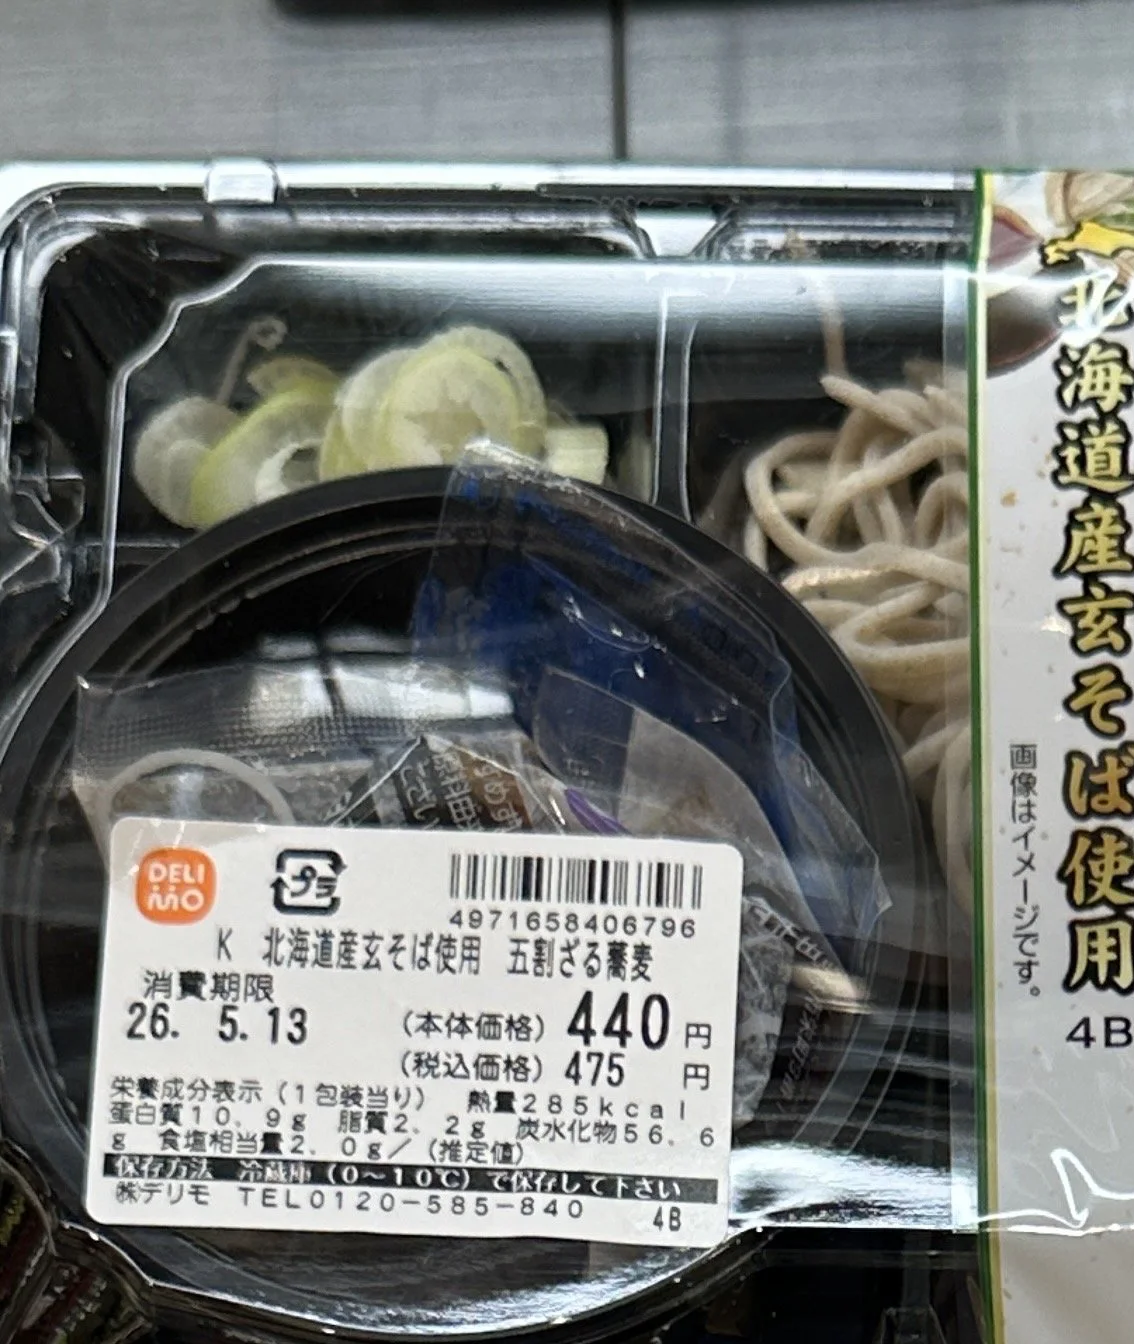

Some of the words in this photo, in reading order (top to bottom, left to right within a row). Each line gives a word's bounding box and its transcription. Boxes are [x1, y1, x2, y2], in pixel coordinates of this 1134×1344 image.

[148, 863, 206, 887] DELI
[288, 869, 336, 898] プラ
[1009, 742, 1042, 997] 画像はイメージです。
[450, 910, 697, 939] 4971658406796
[216, 931, 231, 961] K
[262, 928, 481, 975] 北海道産玄そば使用
[508, 938, 654, 982] 五割ざる蕎麦
[143, 972, 275, 1003] 消費期限
[567, 992, 671, 1051] 440
[686, 1023, 712, 1050] 円
[1066, 1016, 1134, 1048] 4B
[564, 1051, 625, 1088] 475
[683, 1064, 710, 1091] 円
[653, 1206, 682, 1233] 4B
